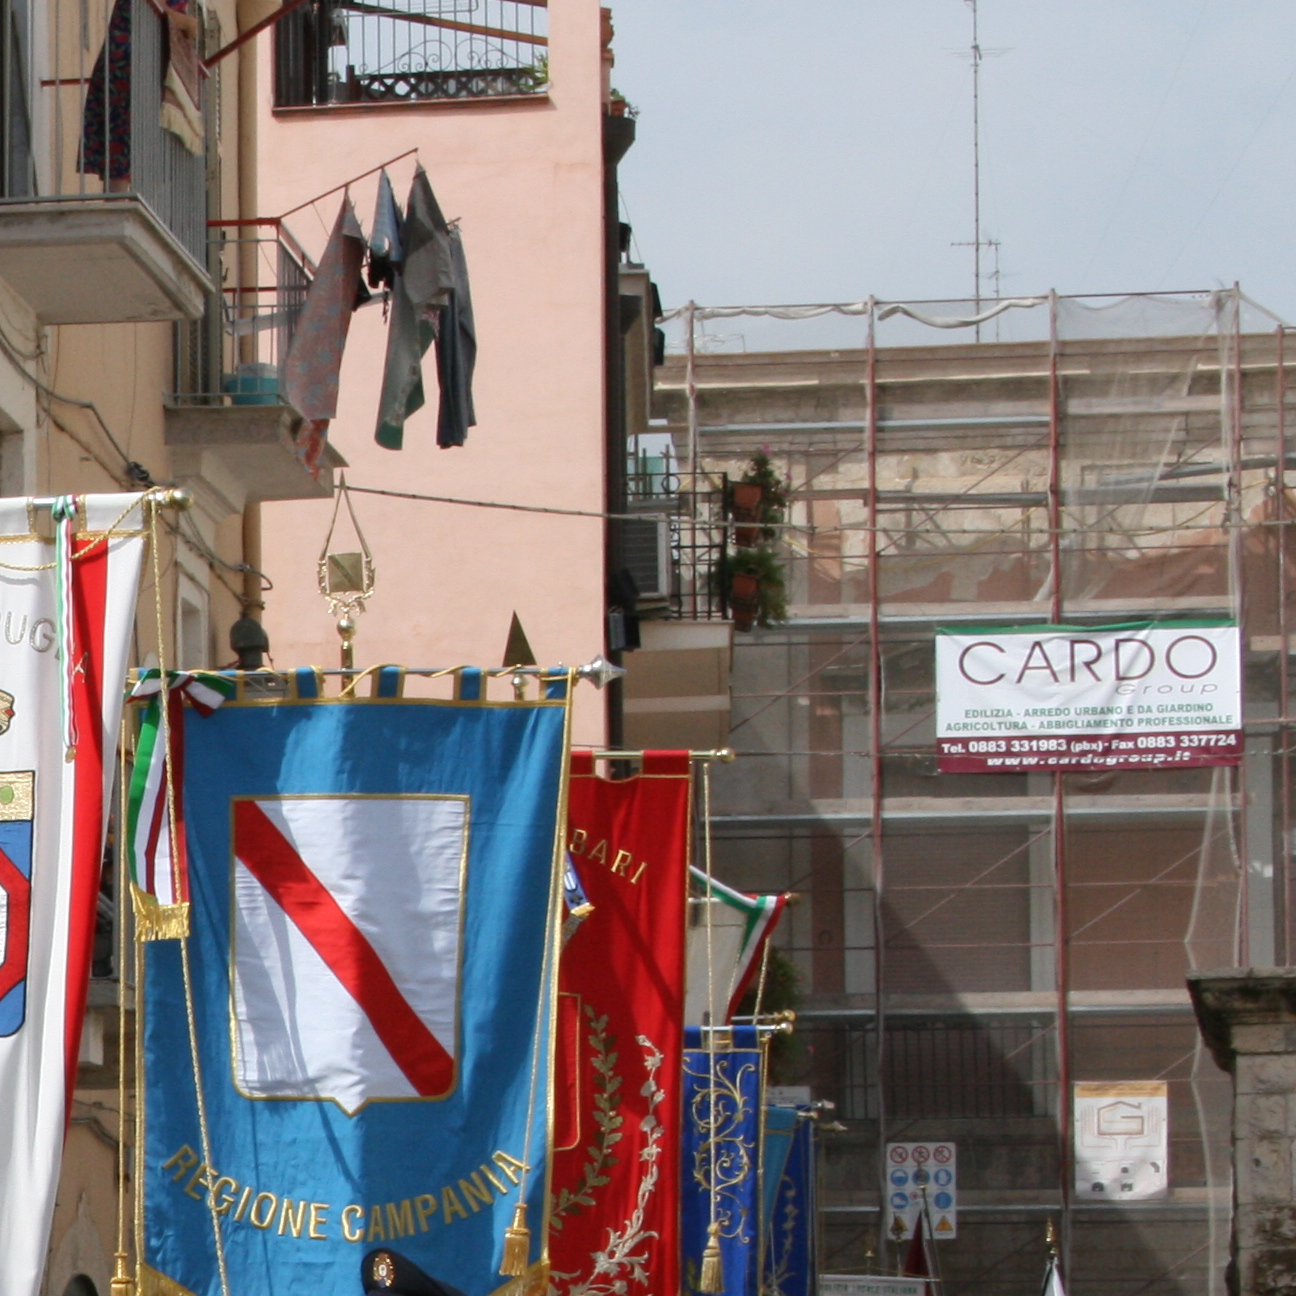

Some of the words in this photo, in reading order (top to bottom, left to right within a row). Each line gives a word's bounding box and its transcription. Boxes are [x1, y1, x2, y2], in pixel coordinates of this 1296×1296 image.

[958, 635, 1217, 686] CARDO
[1115, 682, 1218, 696] Group
[963, 708, 1014, 719] EDILIZIA
[1023, 706, 1071, 718] ARREDO
[1073, 704, 1124, 717] URBANO
[1126, 704, 1135, 715] E
[1137, 704, 1154, 715] DA
[1156, 702, 1214, 714] GIARDINO
[944, 720, 1029, 732] AGRICOLTURA
[1038, 718, 1135, 730] ABBIGLIAMENTO
[1137, 714, 1234, 727] PROFESSIONALE
[941, 742, 967, 754] Tel.
[968, 740, 1008, 753] 0883
[1010, 738, 1068, 752] 331983
[1070, 739, 1103, 753] (pbx)
[1111, 739, 1136, 750] Fax
[1137, 735, 1177, 749] 0883
[1179, 733, 1238, 748] 337724
[569, 828, 648, 884] BARI
[161, 1143, 331, 1241] REGIONE
[341, 1149, 532, 1244] CAMPANIA
